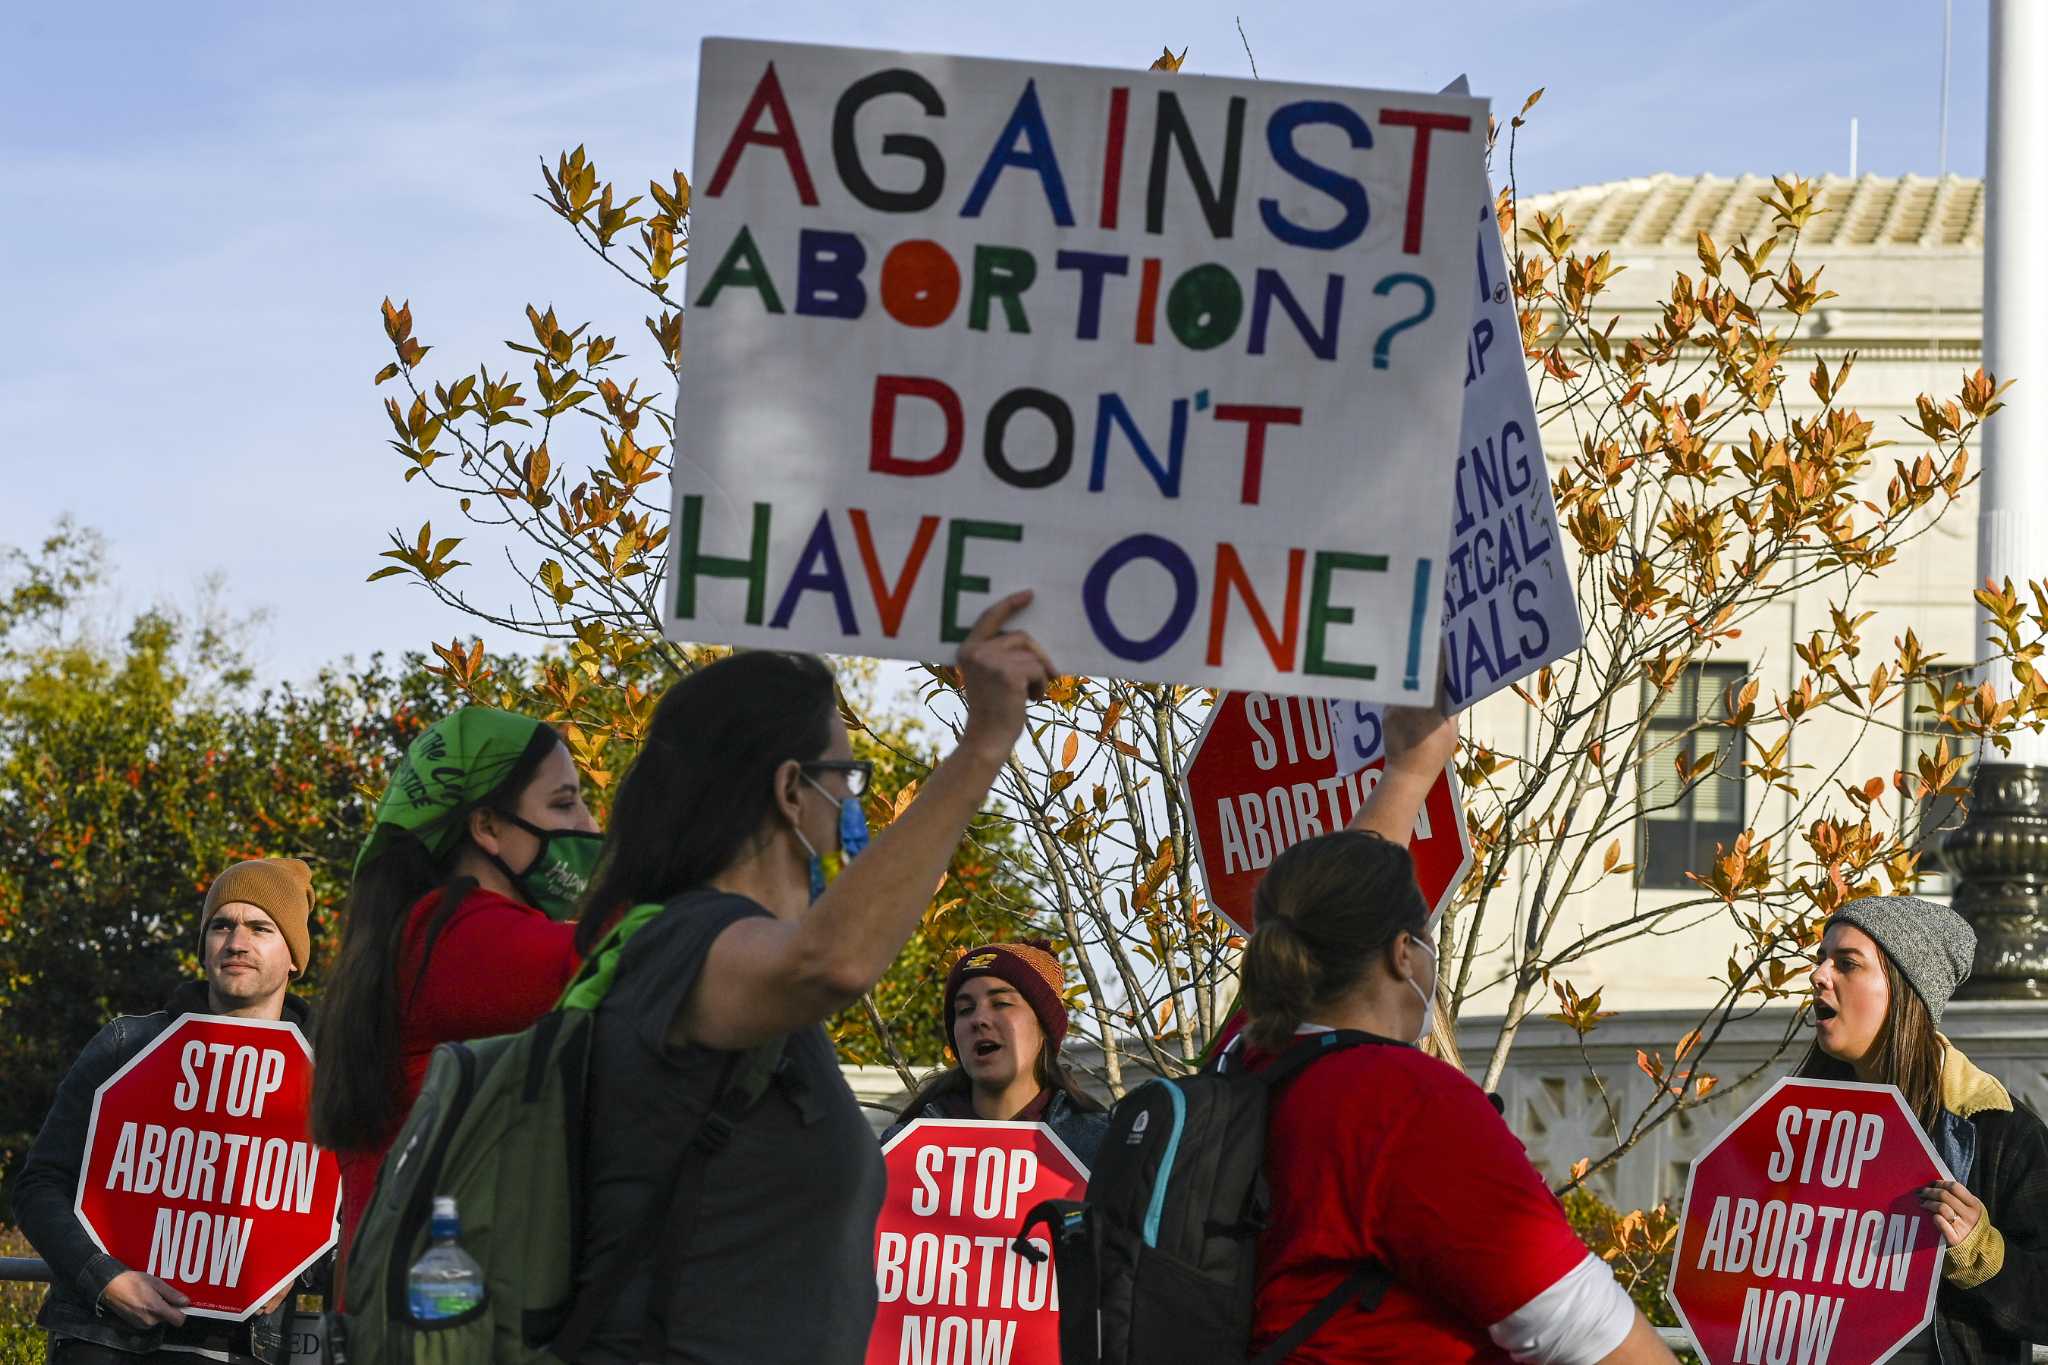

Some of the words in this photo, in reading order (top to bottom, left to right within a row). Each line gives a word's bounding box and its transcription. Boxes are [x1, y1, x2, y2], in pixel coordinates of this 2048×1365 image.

[704, 60, 1471, 255] AGAINST
[695, 225, 1436, 370] ABORTION?
[869, 374, 1302, 505] DON'T
[1455, 420, 1531, 537] ING
[674, 495, 1024, 643] HAVE
[1082, 533, 1432, 691] ONE!
[1244, 690, 1334, 771] STO
[174, 1040, 286, 1118] STOP
[105, 1121, 321, 1214] ABORTION
[911, 1144, 1038, 1219] STOP
[1767, 1105, 1885, 1189] STOP
[146, 1207, 254, 1288] NOW
[876, 1231, 1059, 1312] BORTIO
[1697, 1195, 1920, 1292] ABORTION
[898, 1315, 1017, 1365] NOW
[1732, 1287, 1845, 1365] NOW
